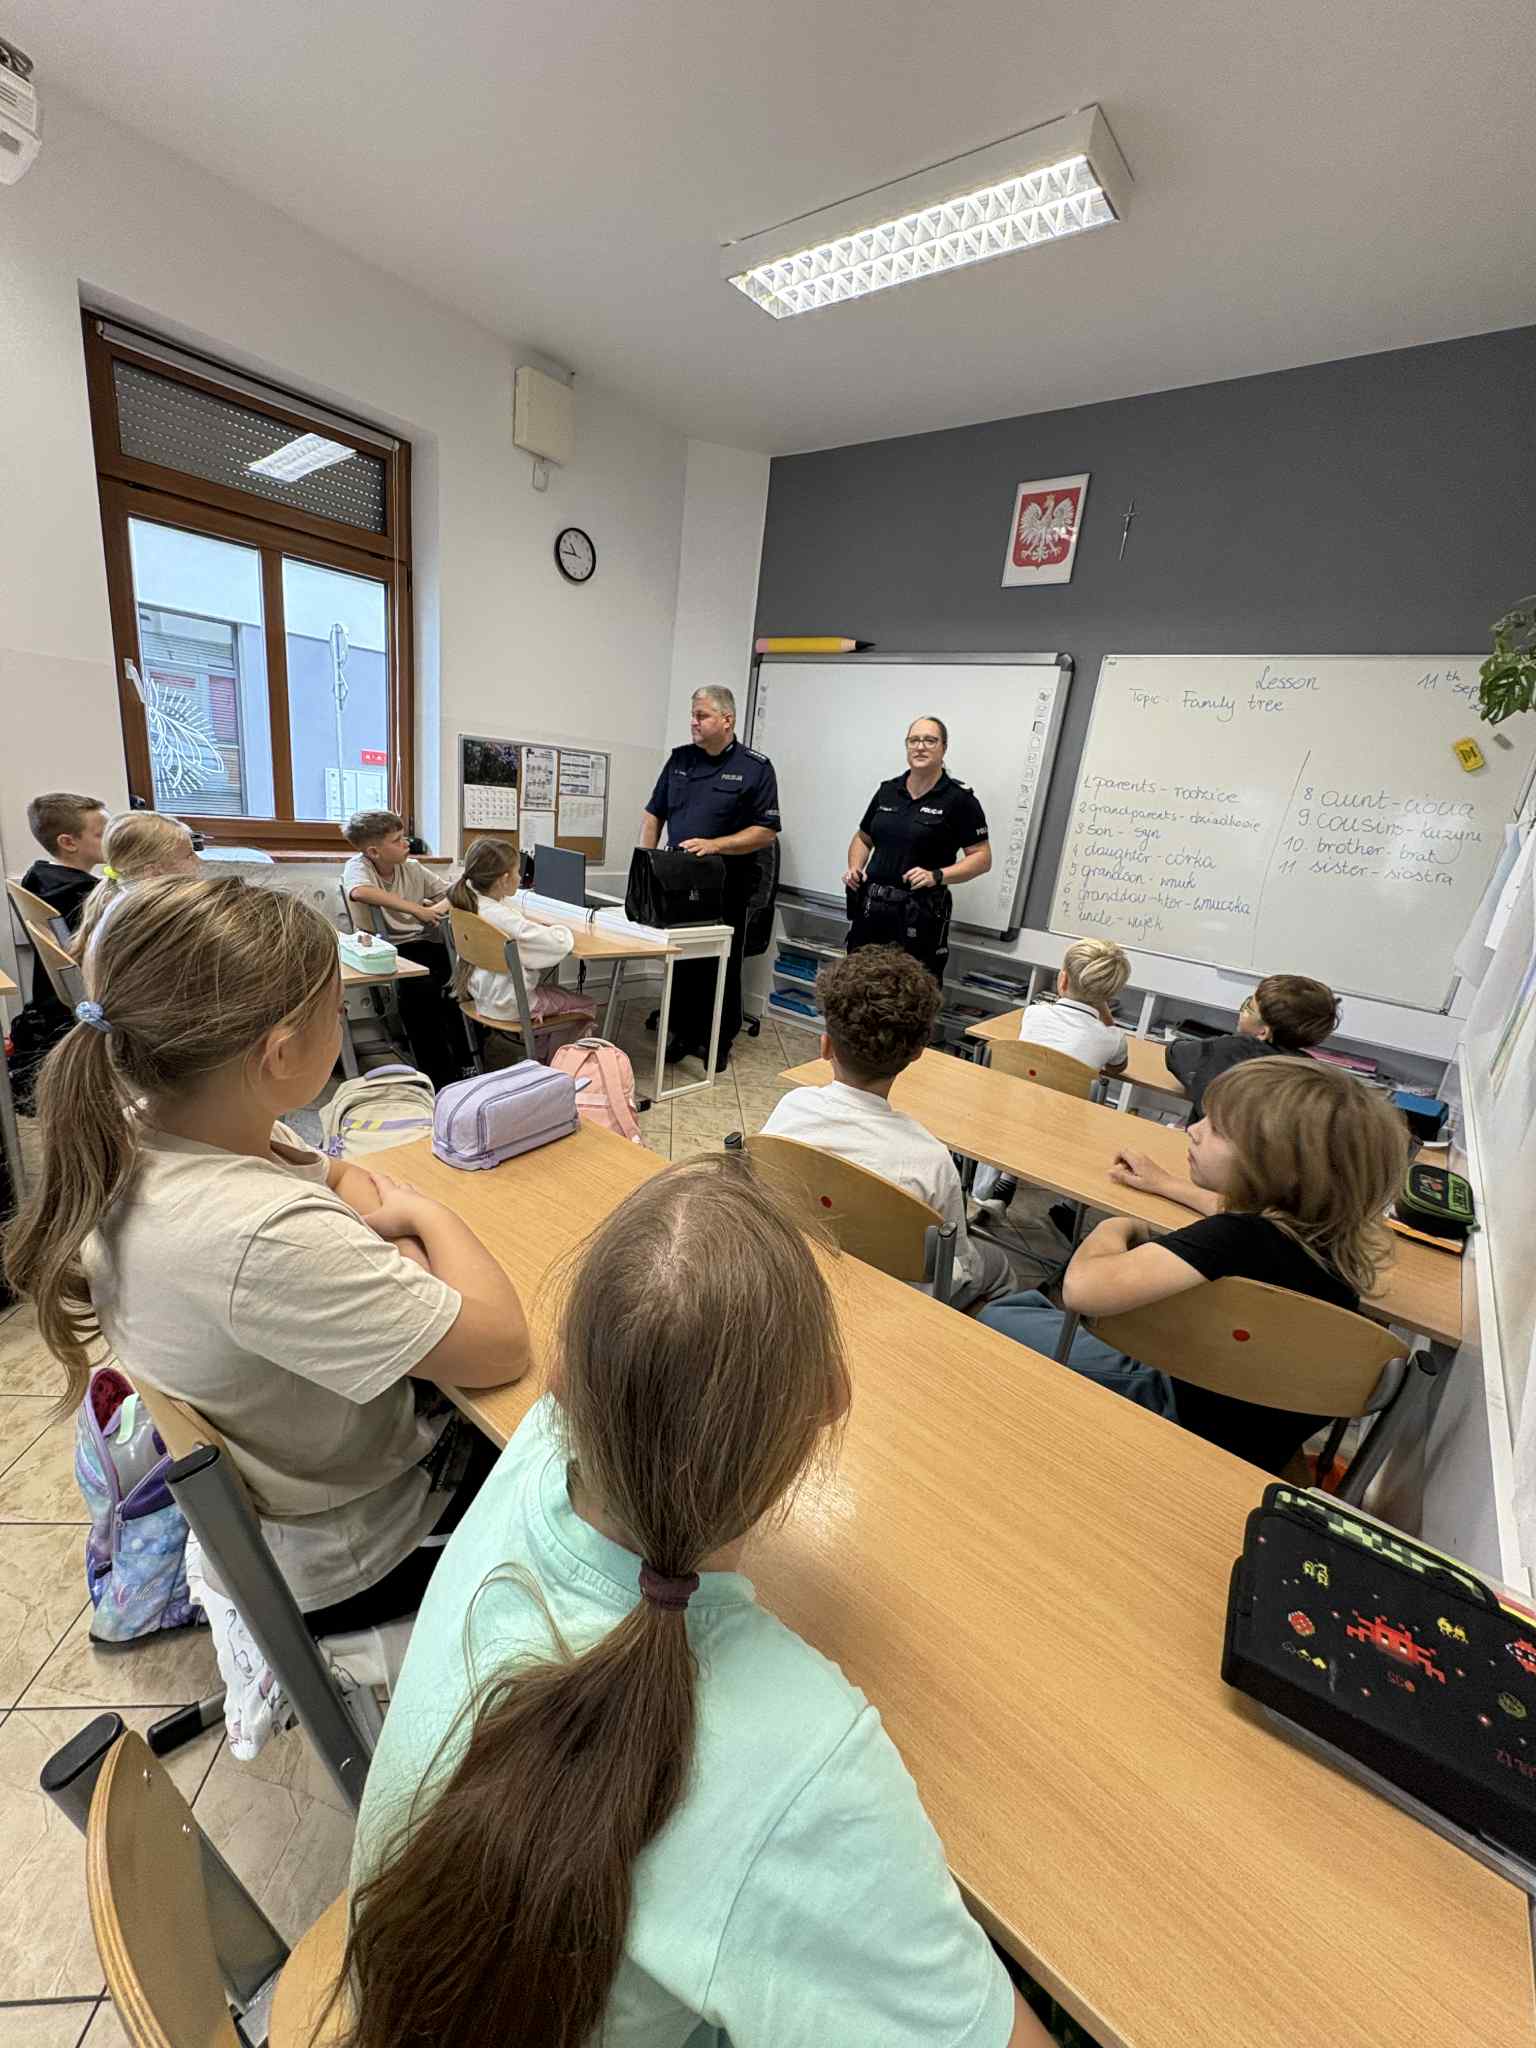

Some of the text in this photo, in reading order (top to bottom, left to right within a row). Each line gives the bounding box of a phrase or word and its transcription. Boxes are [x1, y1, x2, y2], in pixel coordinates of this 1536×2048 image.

[1256, 664, 1320, 690] Lesson
[1129, 688, 1286, 722] Topic Family tree
[1092, 776, 1156, 801] parents
[1303, 786, 1314, 801] 8
[920, 806, 943, 816] POLICJA
[1317, 835, 1386, 856] brother
[1309, 856, 1369, 876] sister
